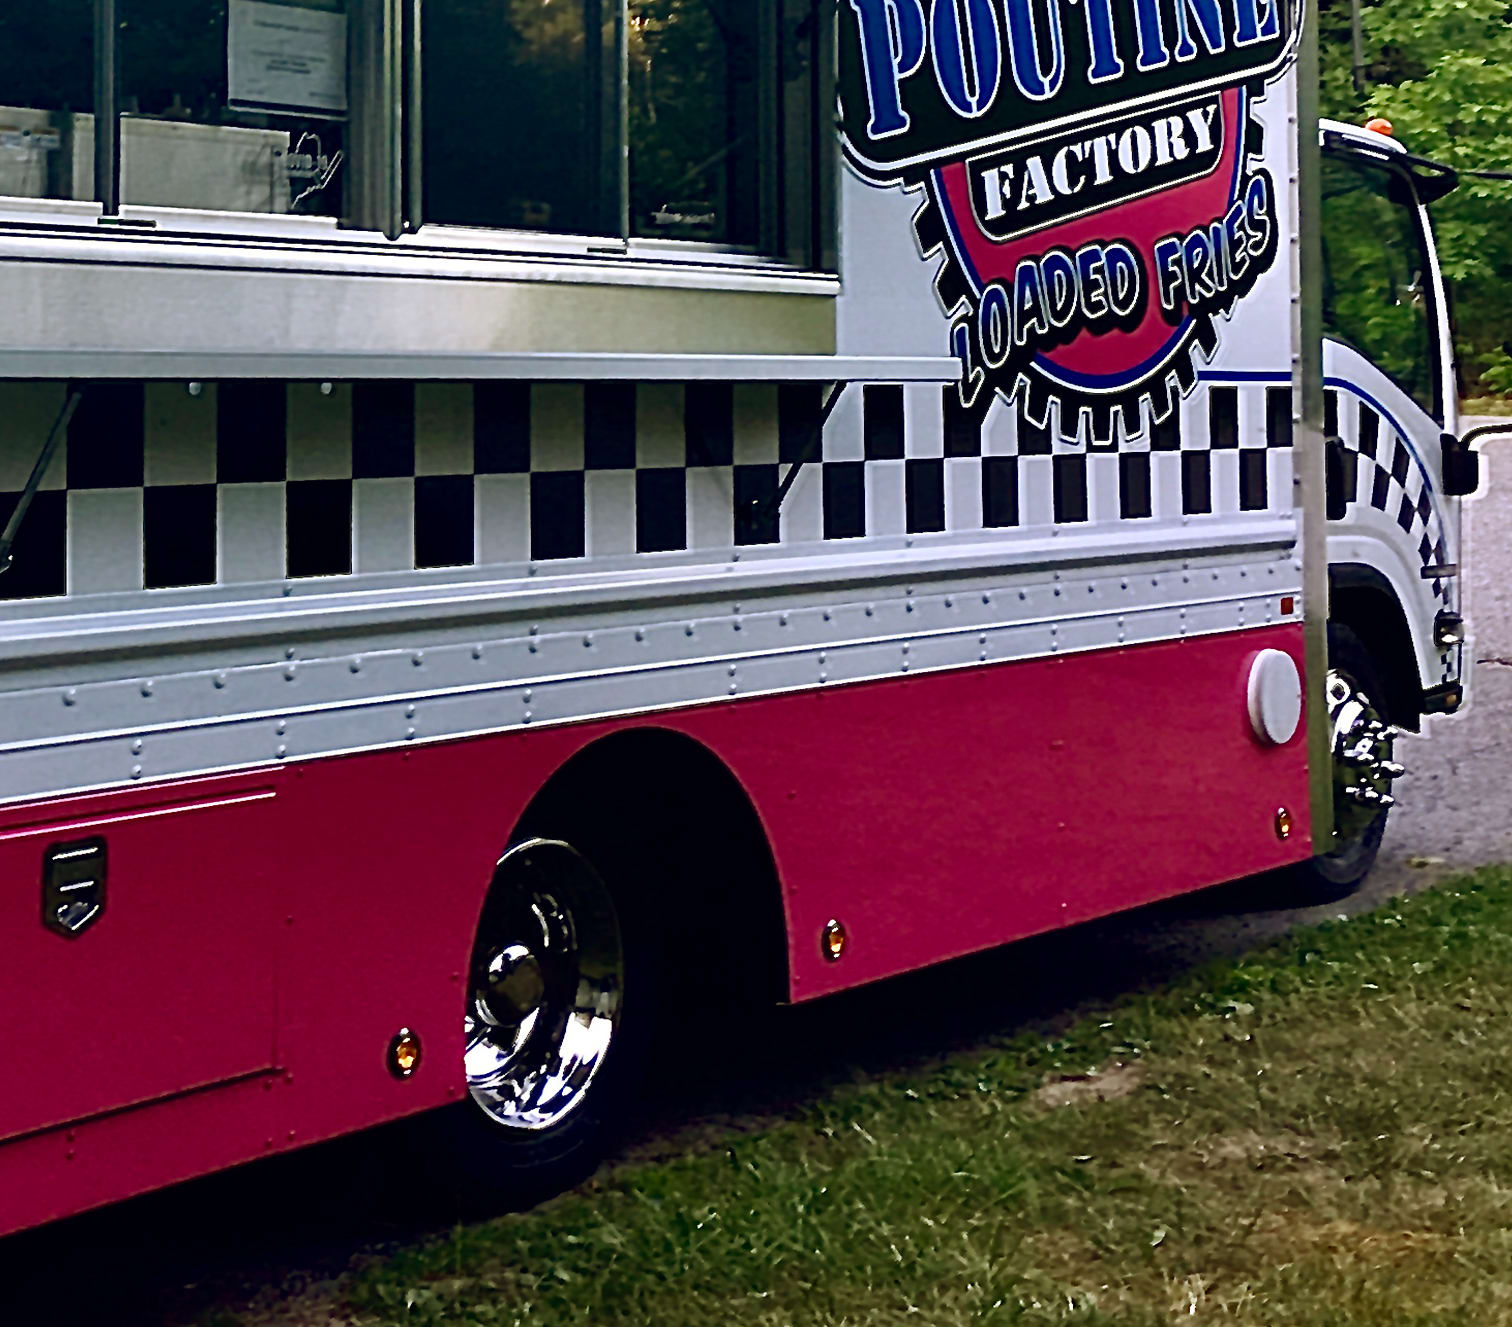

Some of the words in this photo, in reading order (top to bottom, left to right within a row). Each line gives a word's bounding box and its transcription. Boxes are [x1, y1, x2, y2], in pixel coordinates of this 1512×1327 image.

[979, 102, 1220, 221] FACTORY
[950, 243, 1140, 408] LOADED
[1153, 174, 1272, 311] FRIES
